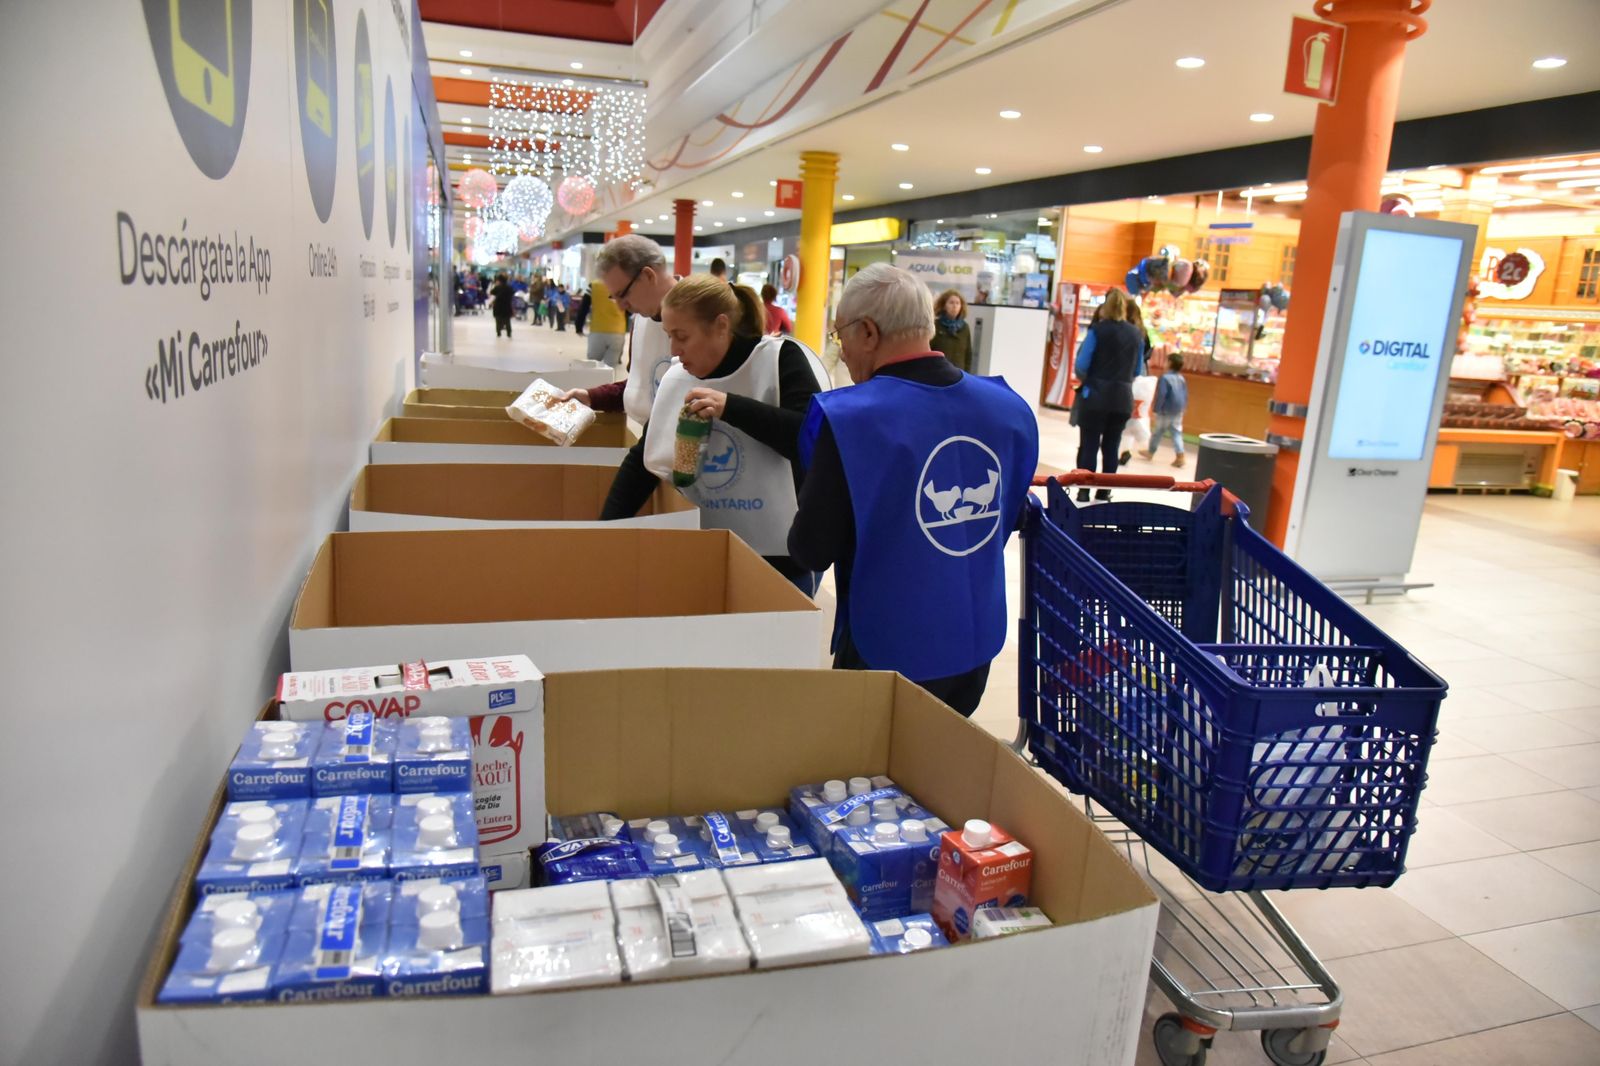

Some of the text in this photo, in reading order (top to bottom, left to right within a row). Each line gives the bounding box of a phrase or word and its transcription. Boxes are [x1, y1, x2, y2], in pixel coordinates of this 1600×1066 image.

[117, 211, 272, 301] Descárgate la App
[308, 243, 328, 277] Online
[907, 263, 936, 274] AQUA
[1372, 340, 1431, 359] DIGITAL
[145, 319, 269, 404] «Mi Carrefour»
[323, 692, 422, 722] COVAP
[490, 692, 504, 704] PLS
[316, 767, 387, 782] Carrefour
[398, 763, 467, 777] Carrefour
[475, 760, 509, 773] Leche
[232, 771, 307, 786] Carrefour
[982, 858, 1031, 877] Carrefour
[861, 880, 899, 893] Carrefour
[279, 982, 376, 1003] Carrefour
[389, 974, 482, 997] Carrefour
